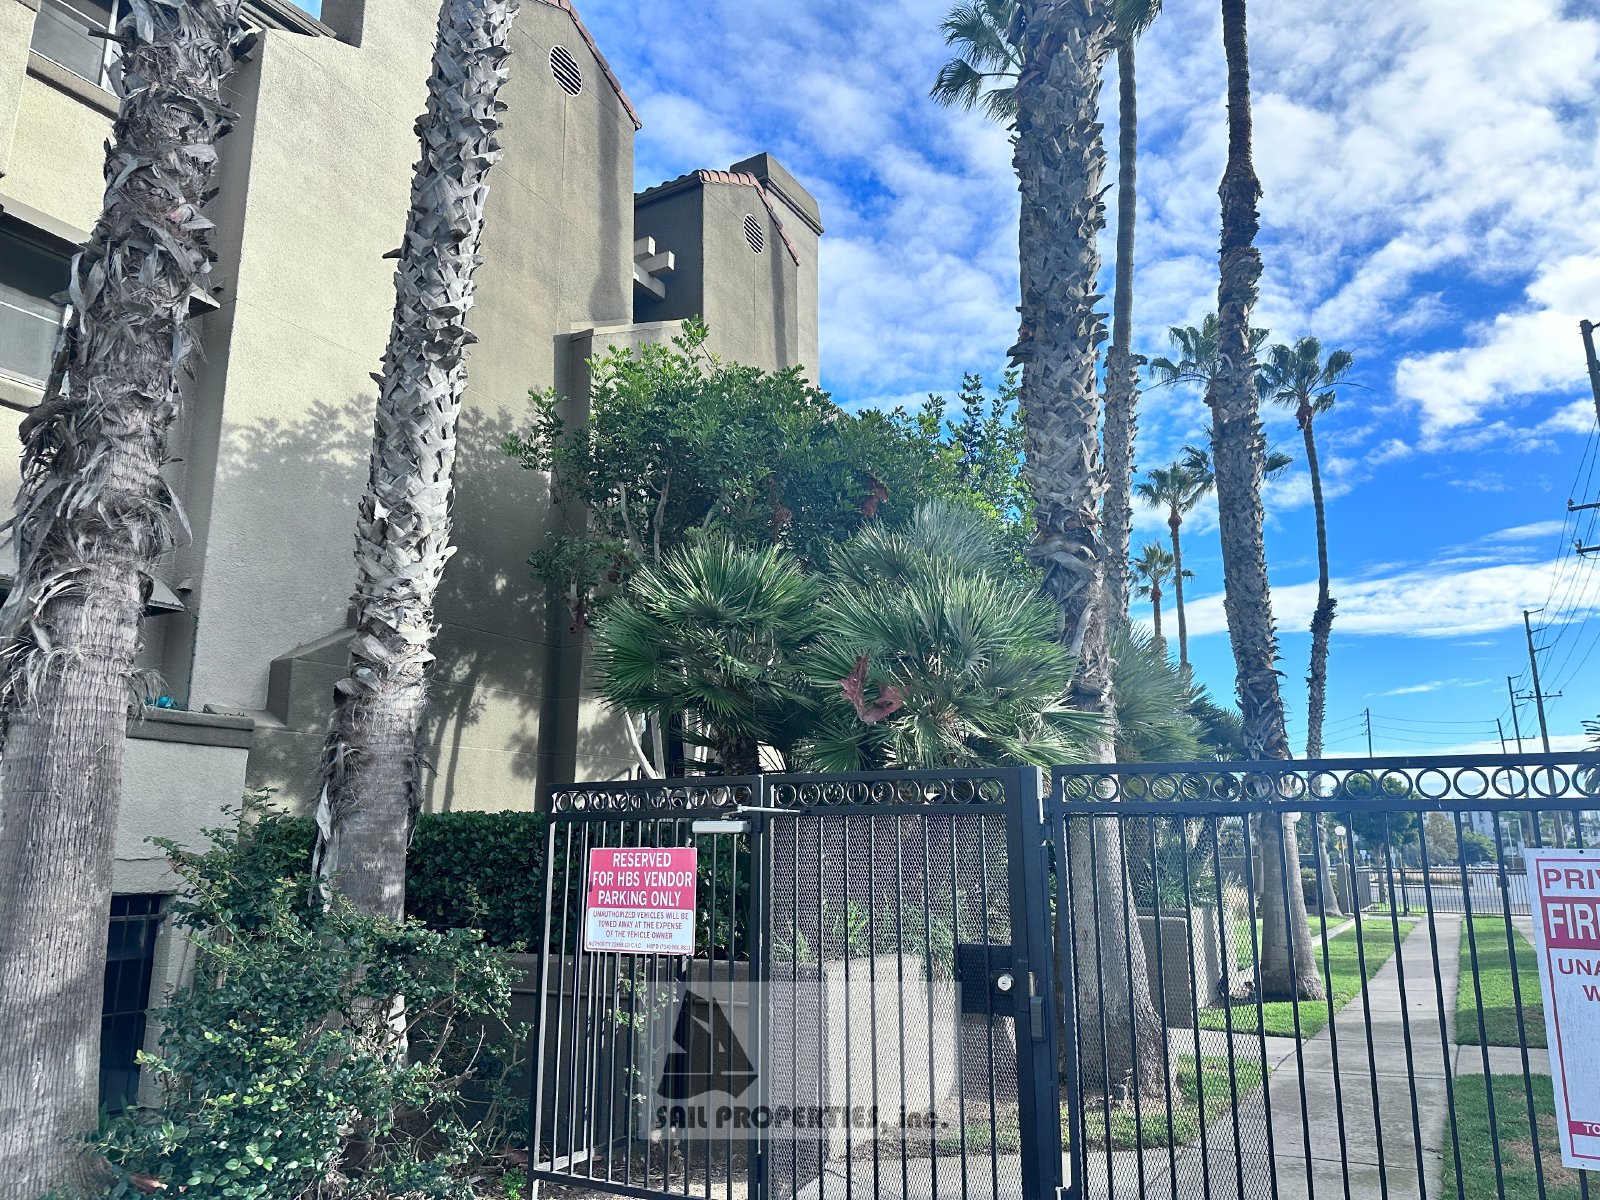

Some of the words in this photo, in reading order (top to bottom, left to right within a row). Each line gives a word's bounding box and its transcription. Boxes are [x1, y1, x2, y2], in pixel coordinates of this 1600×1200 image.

[612, 852, 672, 868] RESERVED
[592, 871, 614, 886] FOR
[617, 871, 640, 887] HBS
[644, 871, 693, 887] VENDOR
[1543, 868, 1600, 890] PRI
[598, 890, 647, 906] PARKING
[651, 891, 681, 907] ONLY
[592, 910, 636, 919] UNAUTHORIZED
[636, 911, 664, 919] VEHICLES
[665, 912, 679, 920] WILL
[680, 912, 689, 920] BE
[1546, 903, 1600, 940] FIR
[598, 920, 617, 928] TOWED
[618, 920, 633, 928] AWAY
[643, 921, 654, 929] THE
[655, 921, 683, 930] EXPENSE
[605, 930, 613, 938] OF
[615, 930, 625, 938] THE
[626, 931, 650, 939] VEHICLE
[651, 931, 673, 939] OWNER
